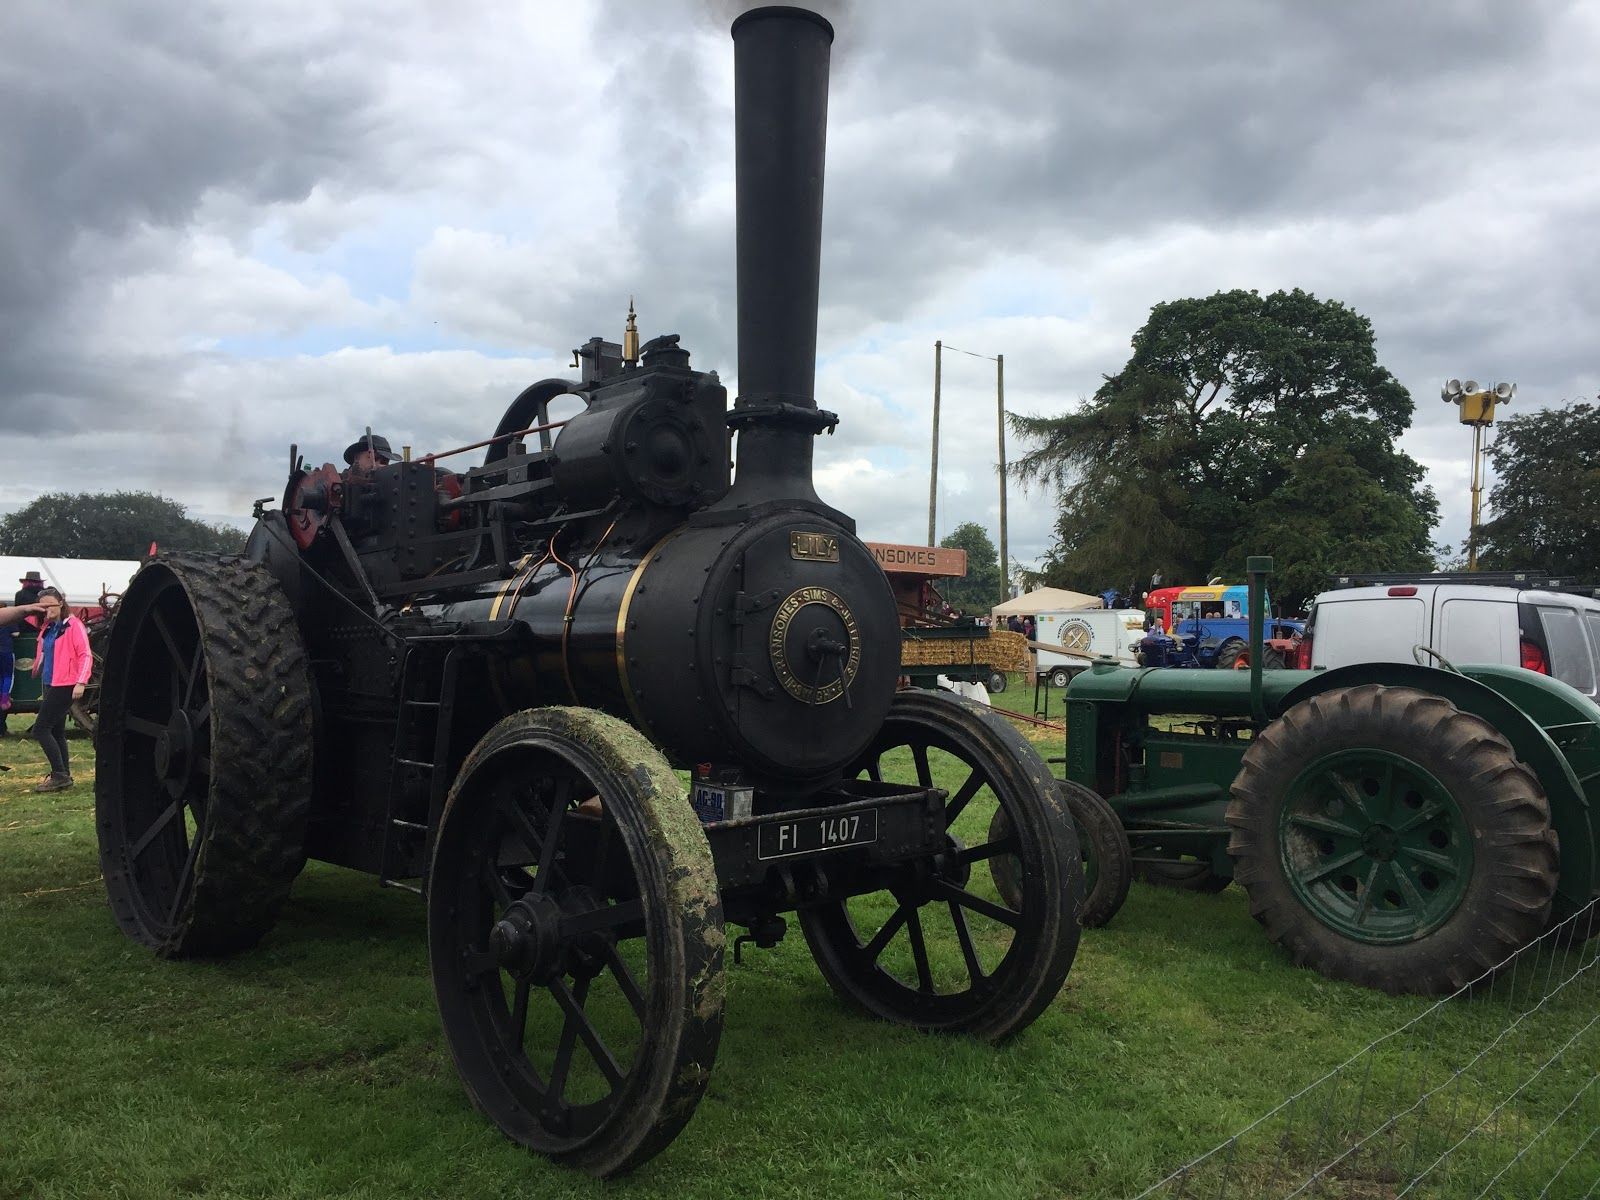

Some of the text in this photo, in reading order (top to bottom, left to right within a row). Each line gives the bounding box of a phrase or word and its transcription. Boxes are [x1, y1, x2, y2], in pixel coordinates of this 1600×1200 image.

[797, 536, 834, 557] LILY
[772, 597, 799, 669] RANSOMES
[802, 589, 828, 601] SIMS
[832, 597, 840, 607] &
[779, 816, 860, 850] FI 1407
